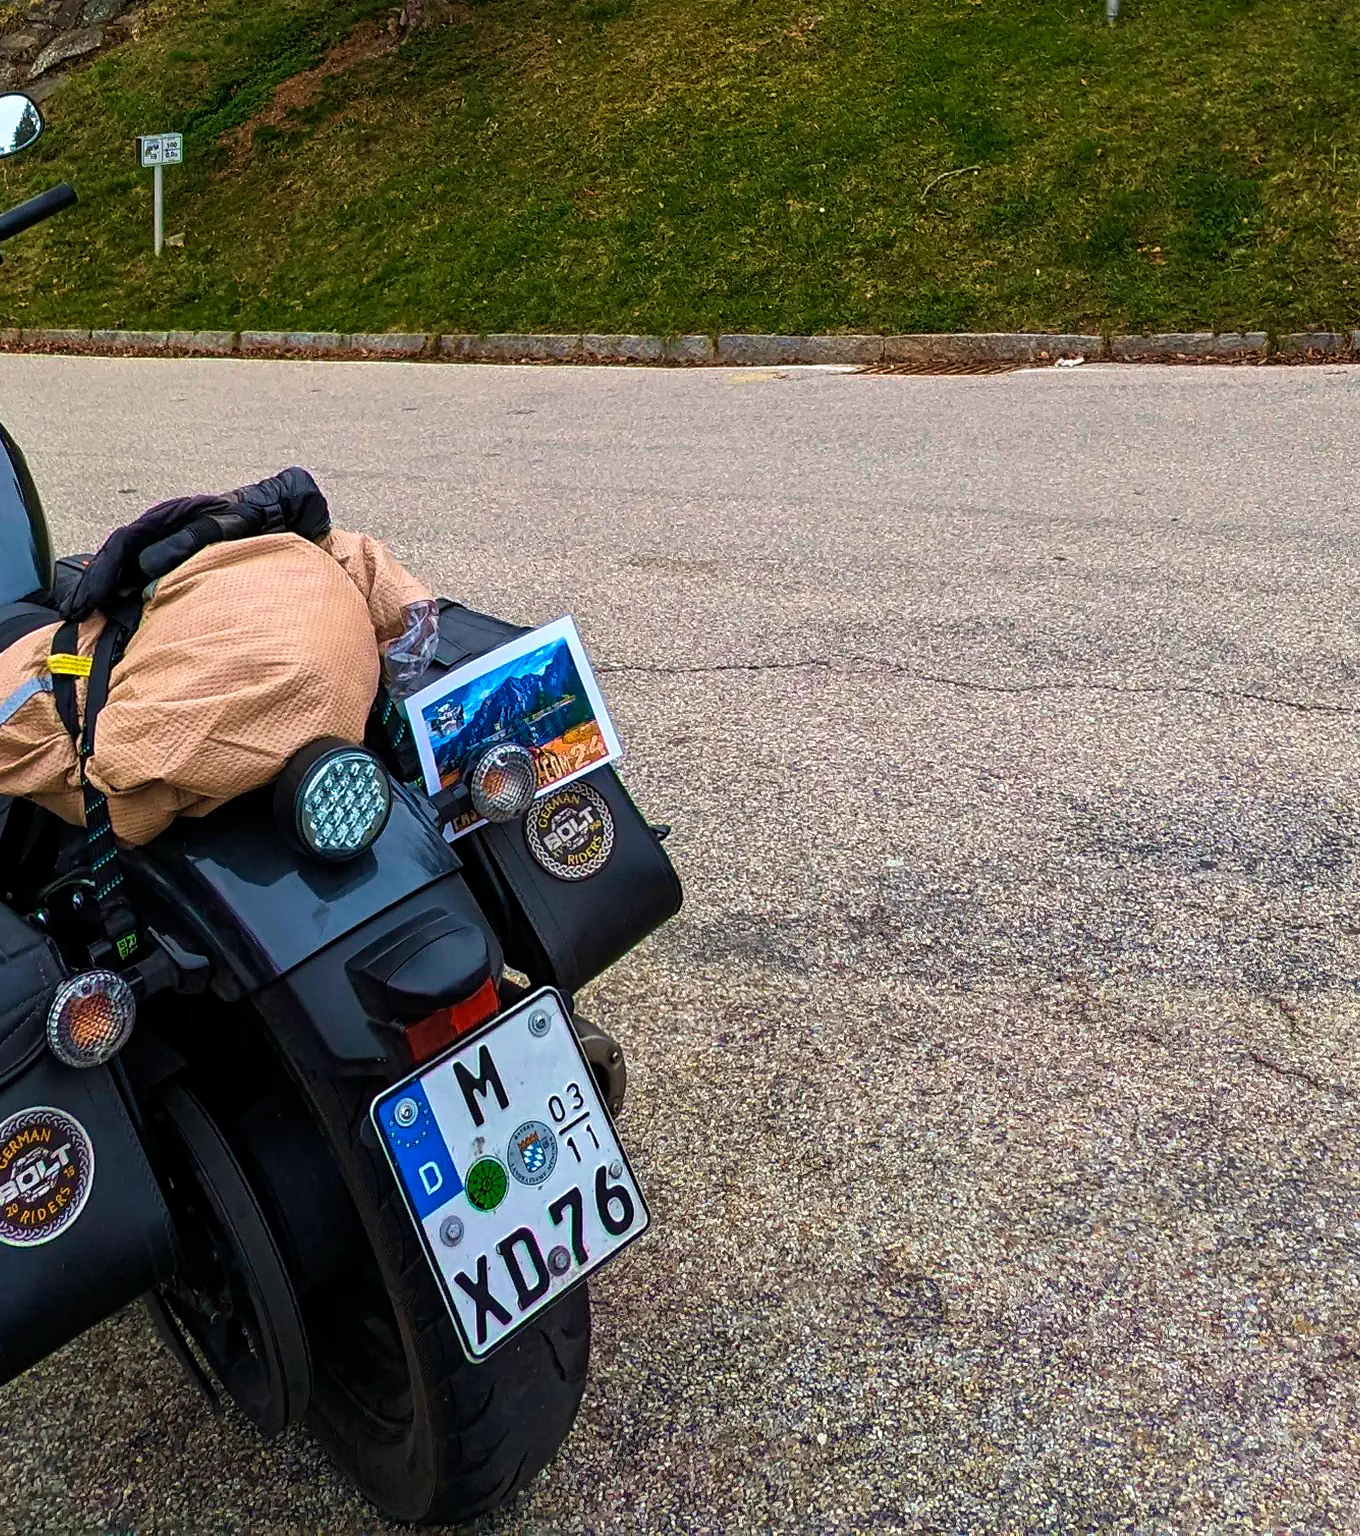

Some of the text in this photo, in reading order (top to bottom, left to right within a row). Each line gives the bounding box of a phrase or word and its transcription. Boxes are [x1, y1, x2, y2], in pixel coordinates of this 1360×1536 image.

[538, 793, 580, 828] GERMAN
[543, 806, 594, 852] BOLT
[567, 835, 602, 865] RIDERS
[452, 1045, 510, 1127] M
[548, 1082, 585, 1123] 03
[565, 1124, 600, 1162] 11
[418, 1160, 444, 1195] D
[5, 1203, 19, 1218] 20
[19, 1185, 71, 1225] RIDERS
[454, 1164, 635, 1345] XD 76
